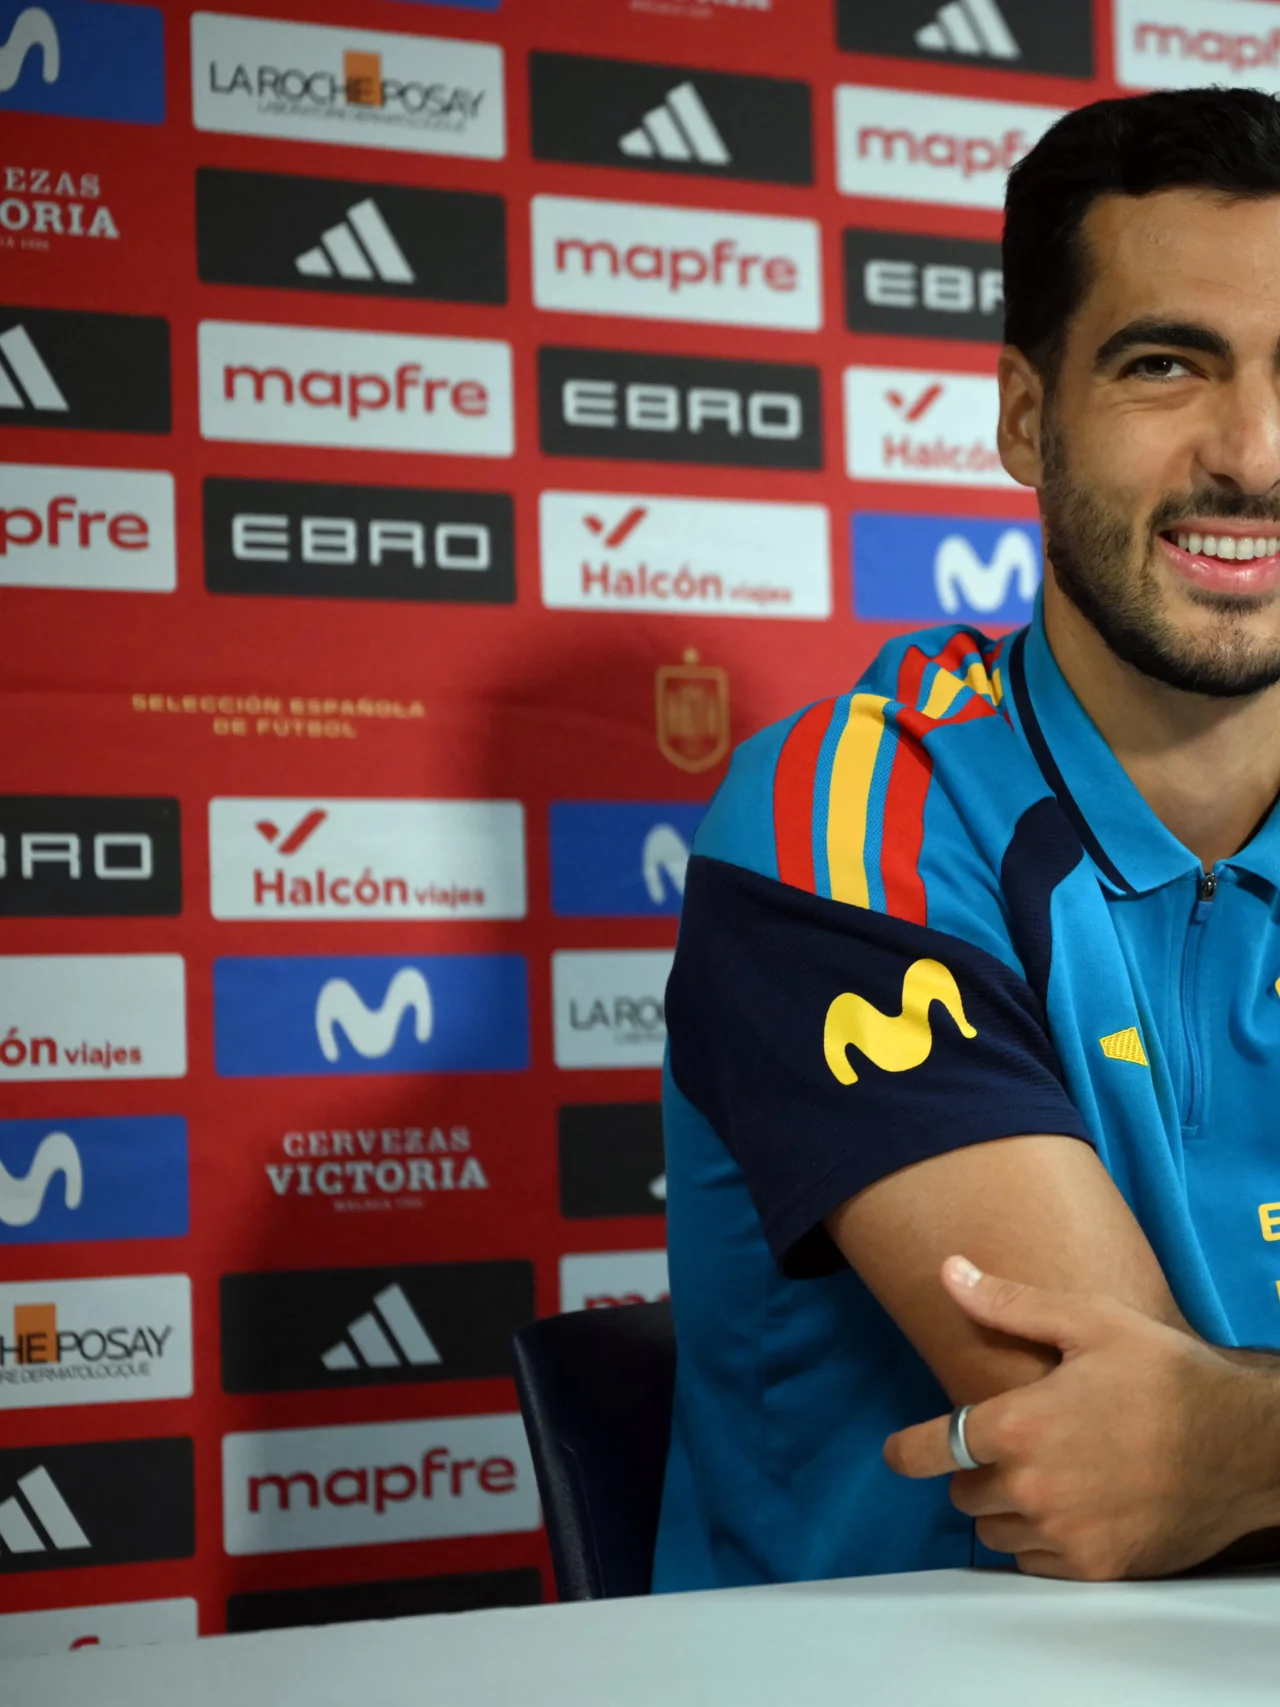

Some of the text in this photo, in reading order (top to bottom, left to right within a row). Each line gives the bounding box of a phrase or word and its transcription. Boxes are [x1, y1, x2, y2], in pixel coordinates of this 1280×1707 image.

[555, 238, 798, 292] mapfre
[223, 364, 487, 419] mapfre
[563, 380, 801, 439] EBRO
[232, 515, 490, 570] EBRO
[581, 562, 722, 599] Halcón
[254, 870, 486, 908] Halcón viajes
[64, 1042, 141, 1069] viajes
[282, 1126, 474, 1158] CERVEZAS
[264, 1155, 490, 1196] VICTORIA
[55, 1323, 174, 1365] POSAY
[248, 1447, 515, 1515] mapfre
